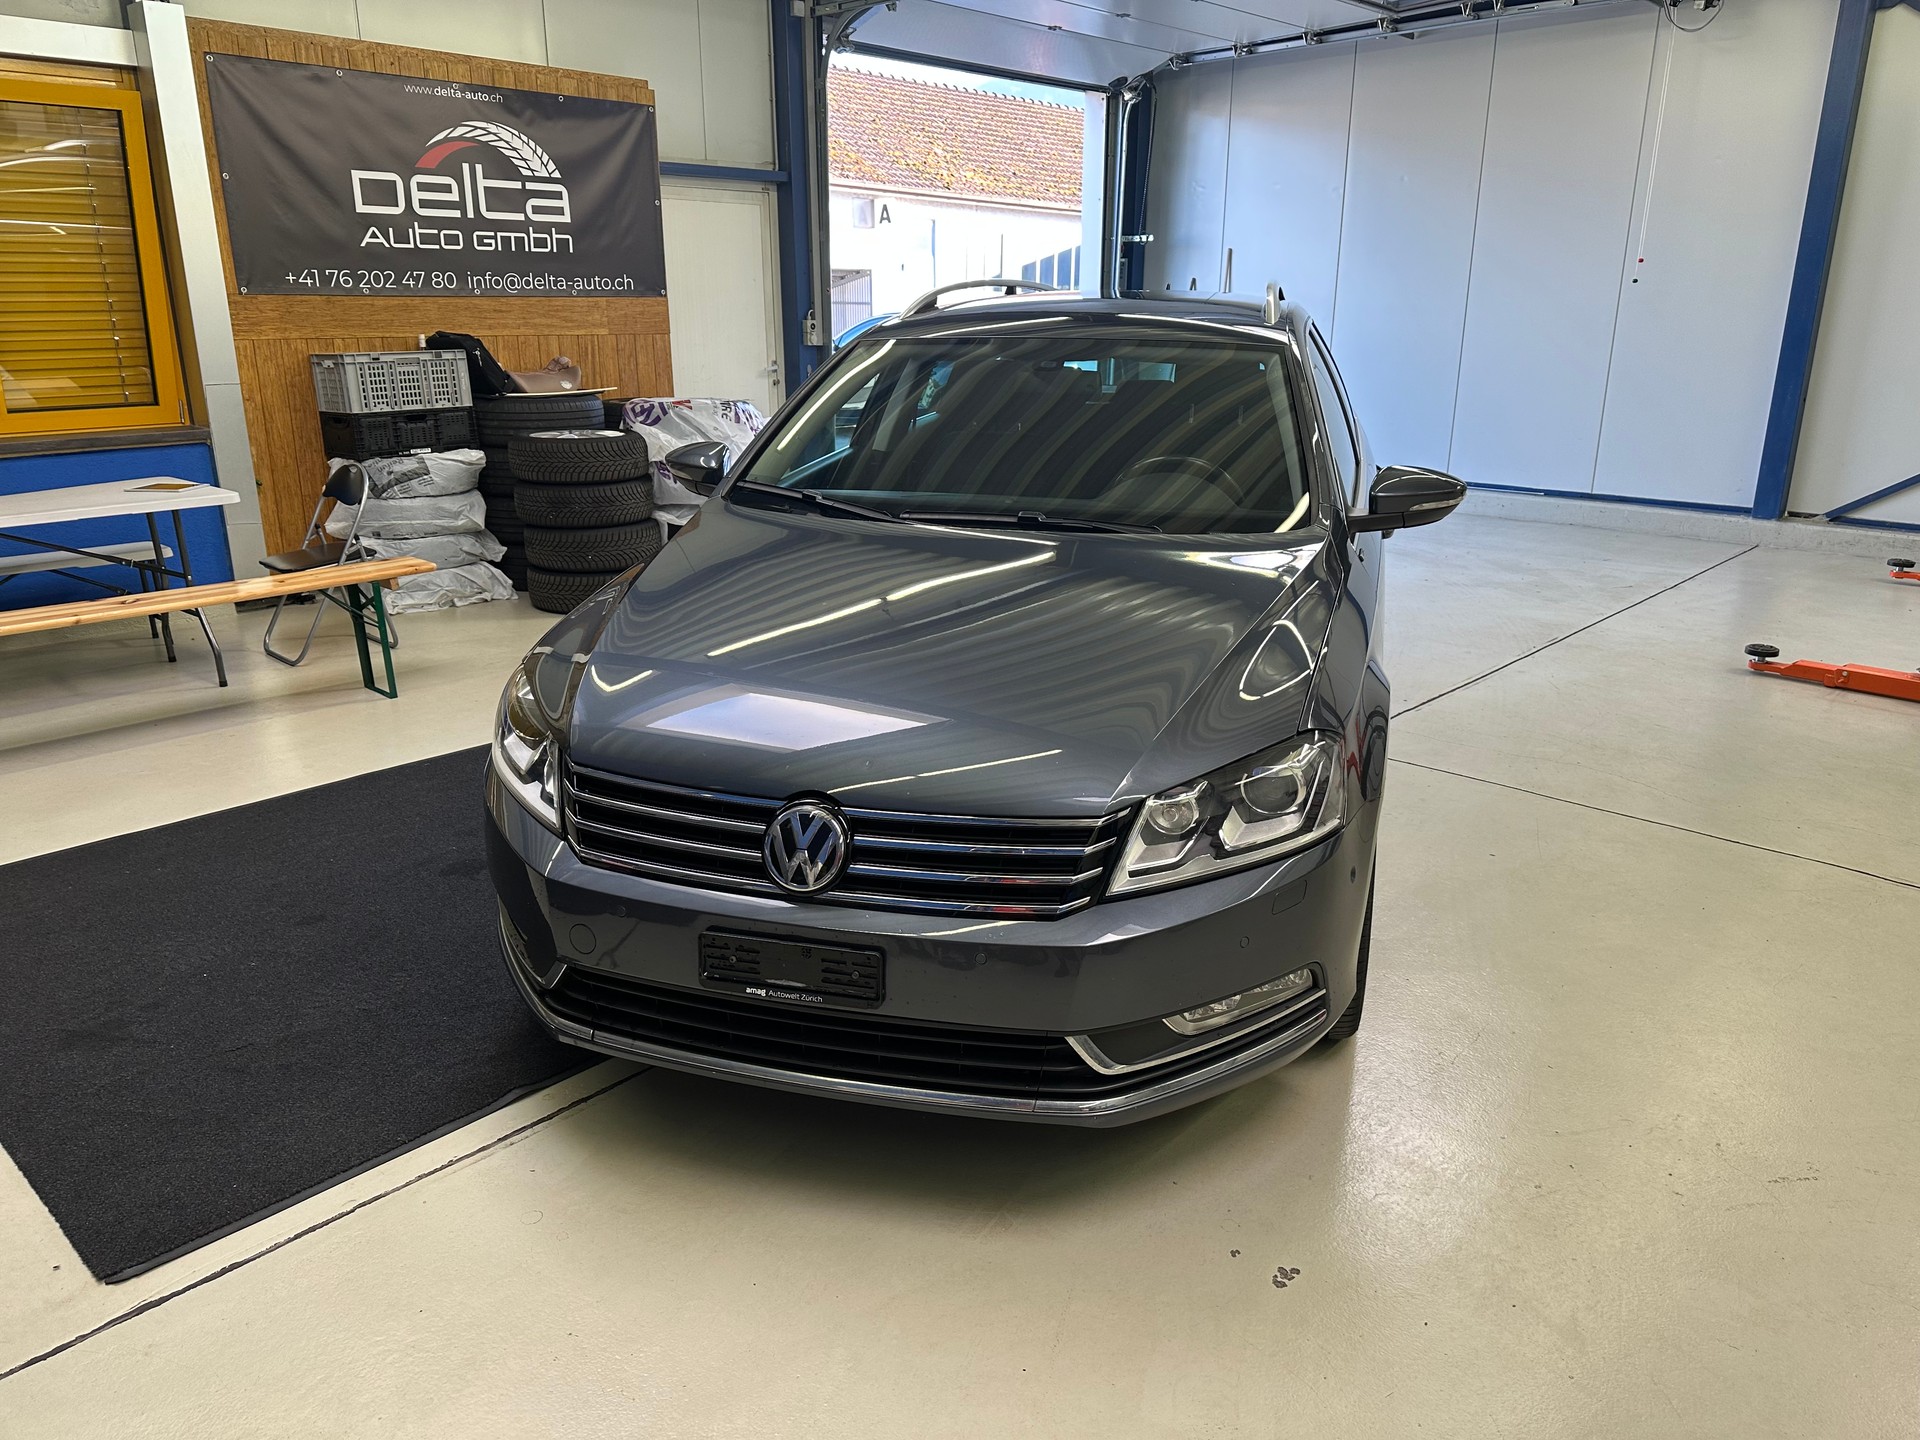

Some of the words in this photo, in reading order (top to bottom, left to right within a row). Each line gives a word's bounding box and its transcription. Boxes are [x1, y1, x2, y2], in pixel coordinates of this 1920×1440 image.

[404, 84, 503, 103] www.delta-auto.ch
[350, 162, 571, 223] Delta
[879, 203, 891, 224] A
[360, 222, 463, 250] Auto
[285, 269, 320, 288] +41
[325, 269, 353, 288] 76
[357, 270, 396, 288] 202
[402, 271, 425, 288] 47
[431, 271, 457, 289] 80
[467, 271, 634, 294] info@delta-auto.ch
[746, 987, 766, 997] amag
[768, 990, 800, 1000] Autowelt
